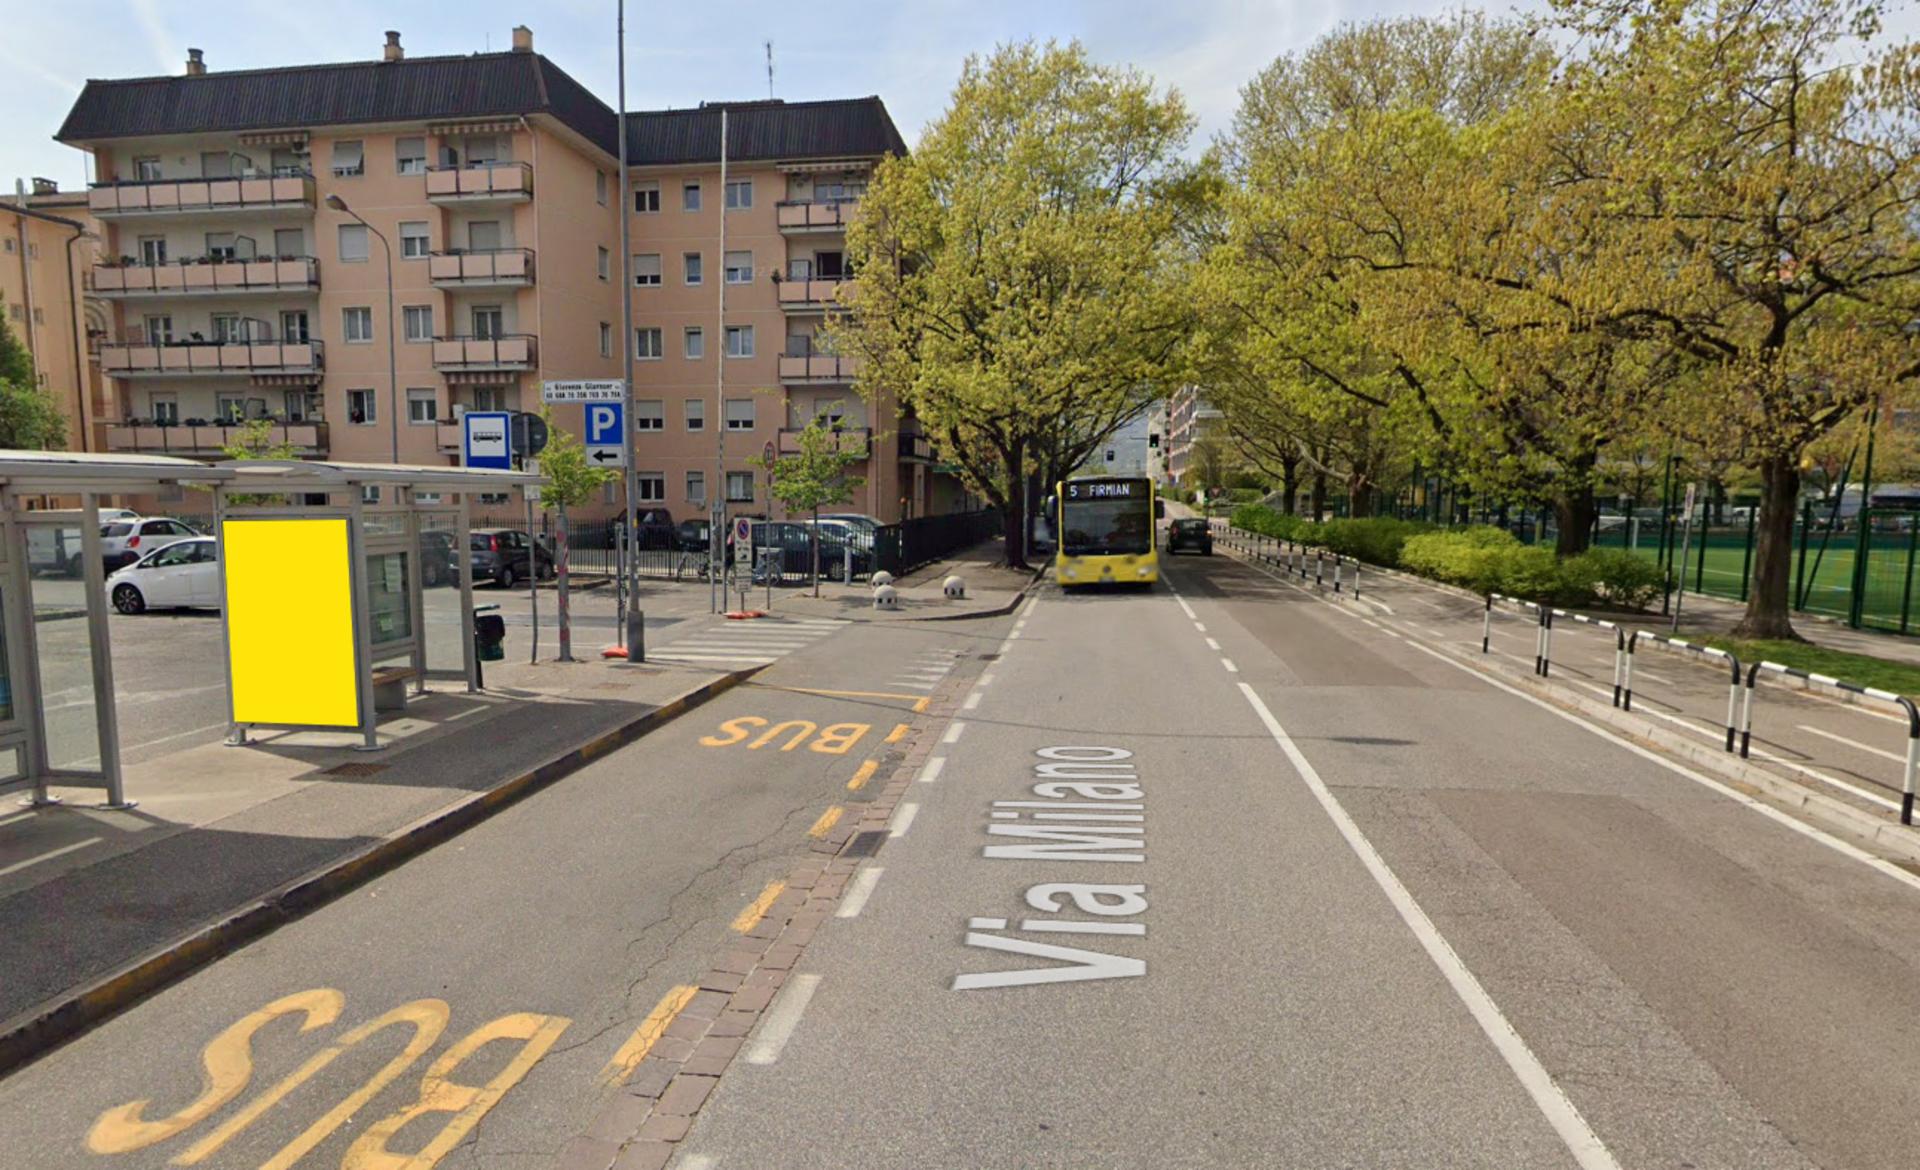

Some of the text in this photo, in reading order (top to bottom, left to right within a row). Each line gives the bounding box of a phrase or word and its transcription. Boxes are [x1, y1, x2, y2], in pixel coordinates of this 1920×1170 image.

[591, 406, 616, 441] P
[1070, 484, 1130, 497] 5 FIRMIAN
[700, 715, 871, 755] BUS
[84, 987, 574, 1170] BUS
